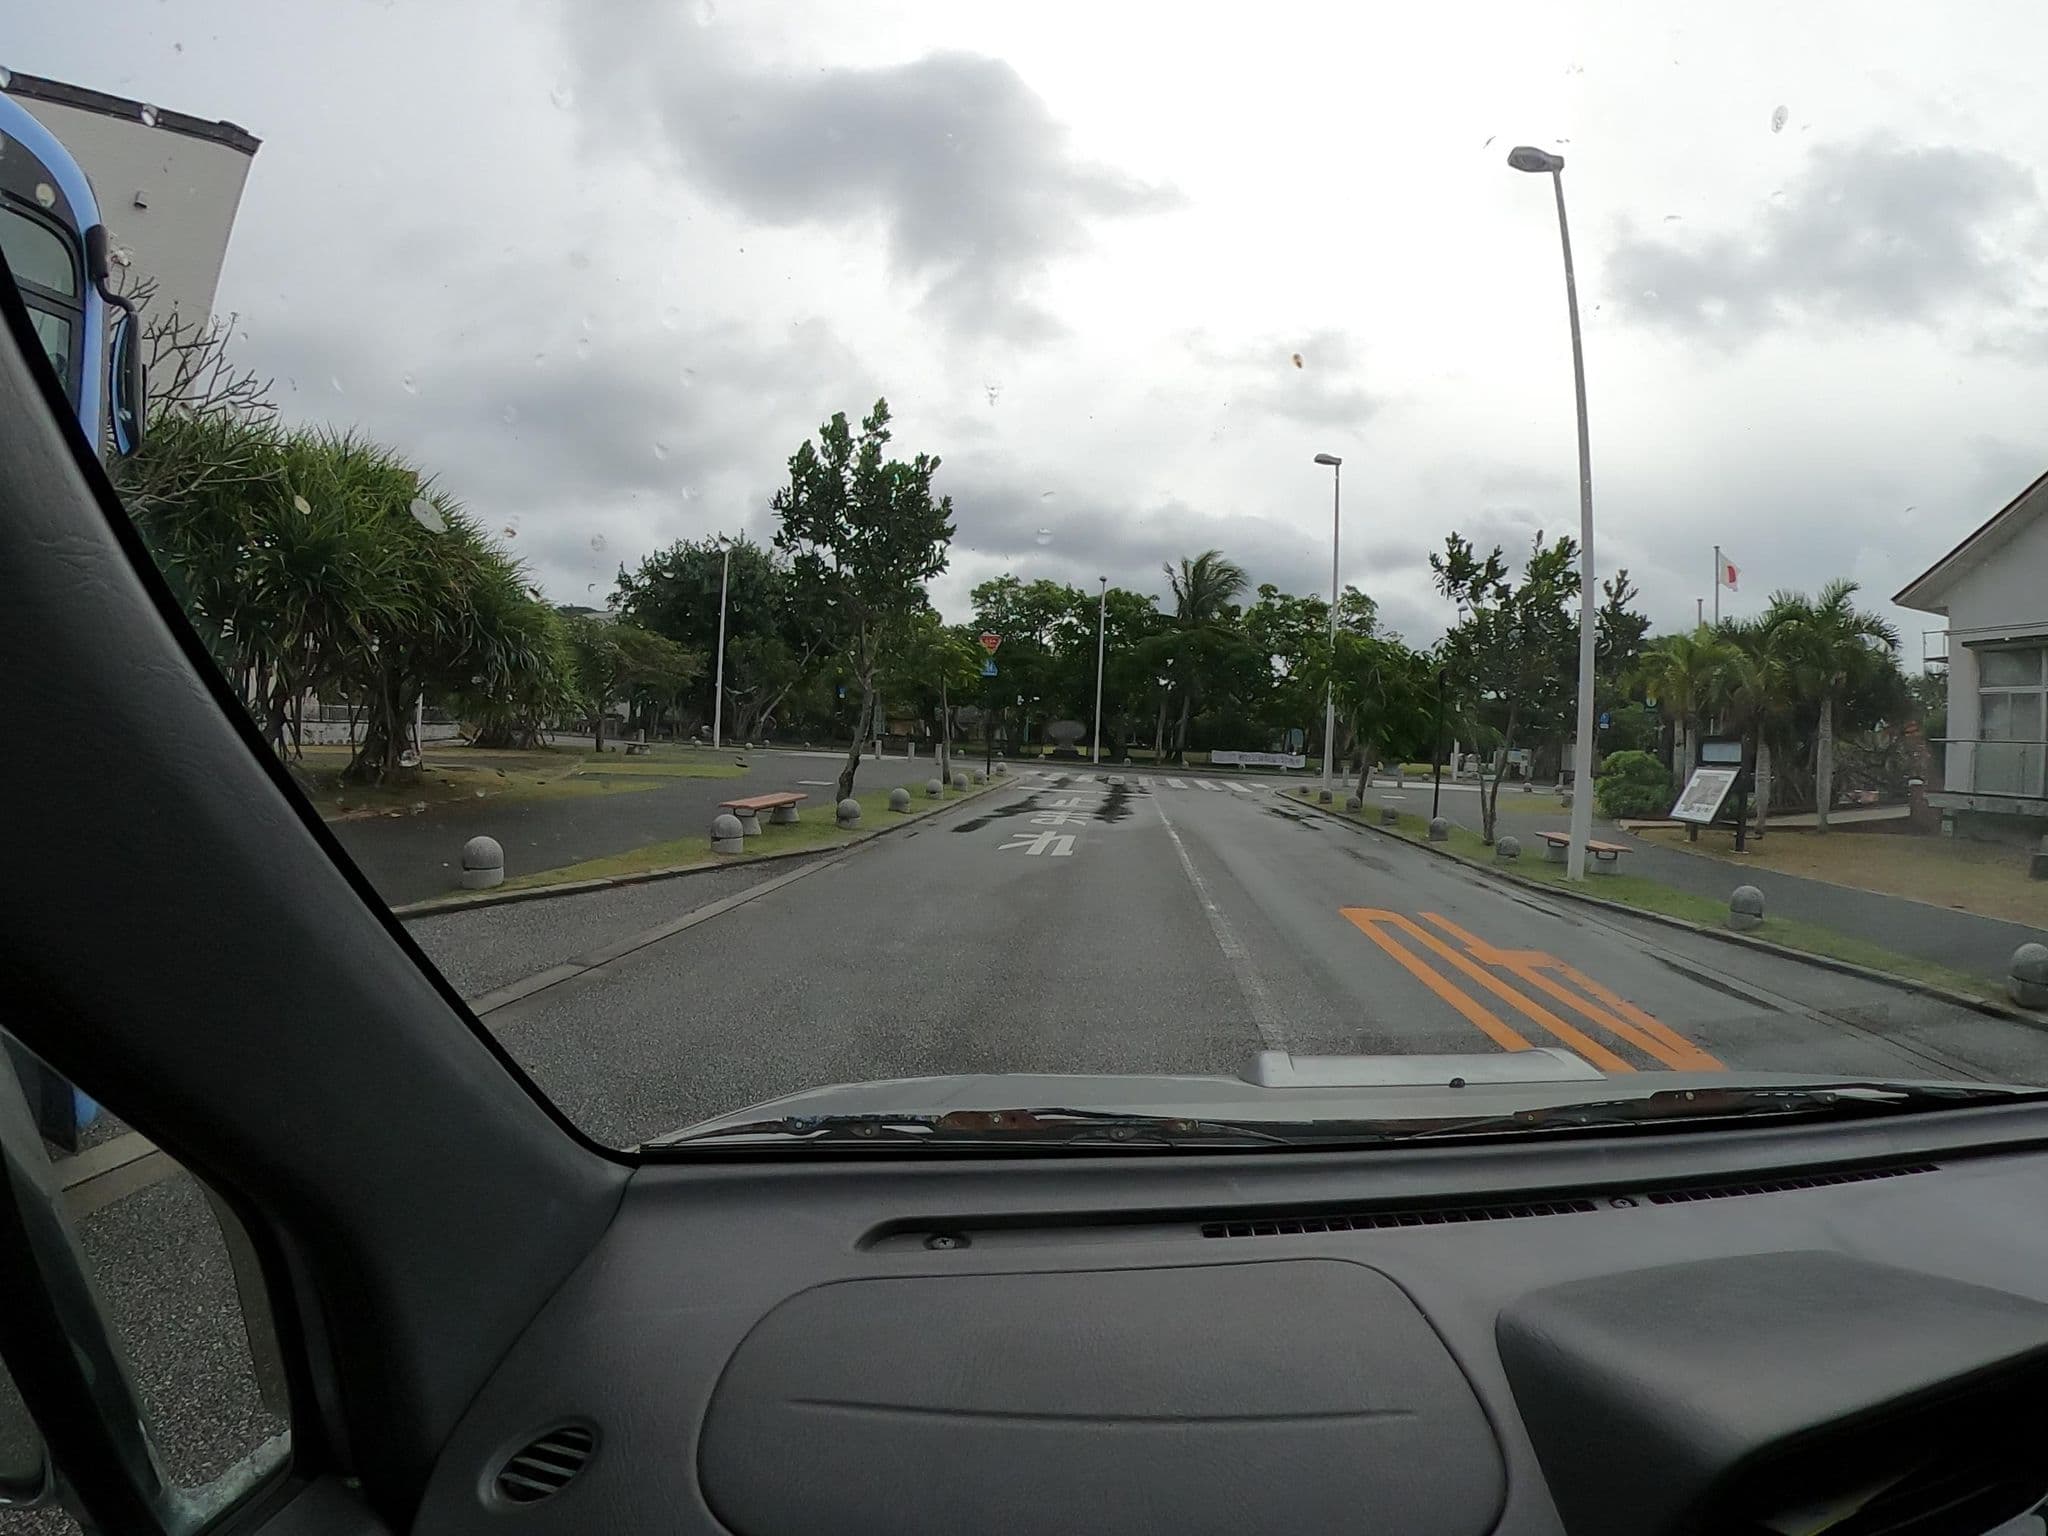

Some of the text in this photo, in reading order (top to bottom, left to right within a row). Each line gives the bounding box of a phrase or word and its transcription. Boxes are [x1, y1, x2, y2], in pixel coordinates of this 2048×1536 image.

[998, 797, 1097, 856] 止まれ
[1341, 907, 1725, 1073] 40
